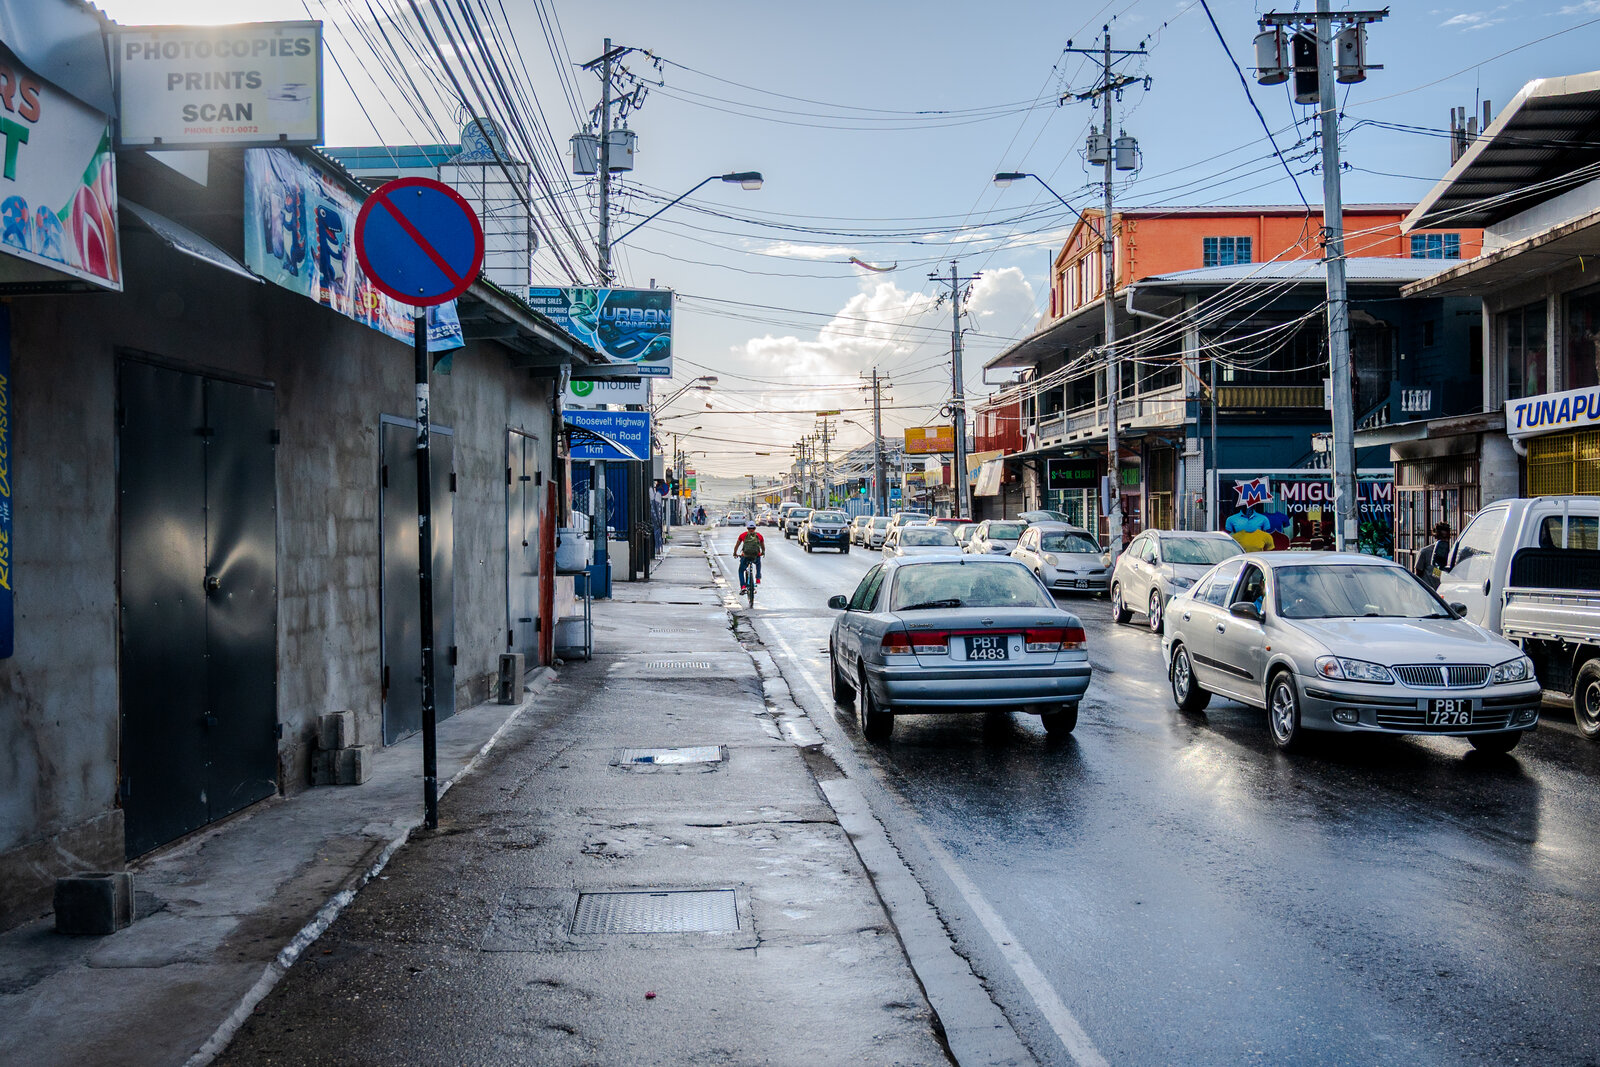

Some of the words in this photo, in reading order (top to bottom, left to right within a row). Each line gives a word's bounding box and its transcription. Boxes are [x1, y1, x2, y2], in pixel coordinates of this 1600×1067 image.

[126, 38, 311, 61] PHOTOCOPIES
[167, 71, 263, 91] PRINTS
[182, 103, 253, 122] SCAN
[603, 307, 671, 321] URBAN
[615, 320, 657, 328] CONNECT
[576, 416, 612, 426] Roosevelt
[615, 417, 646, 428] Highway
[620, 431, 641, 440] Road
[584, 445, 604, 454] 1km
[1280, 482, 1367, 501] MIGUL
[1287, 503, 1320, 513] YOUR
[973, 637, 998, 649] PBT
[970, 648, 1005, 660] 4483
[1435, 699, 1464, 712] PBT
[1430, 711, 1468, 725] 7276
